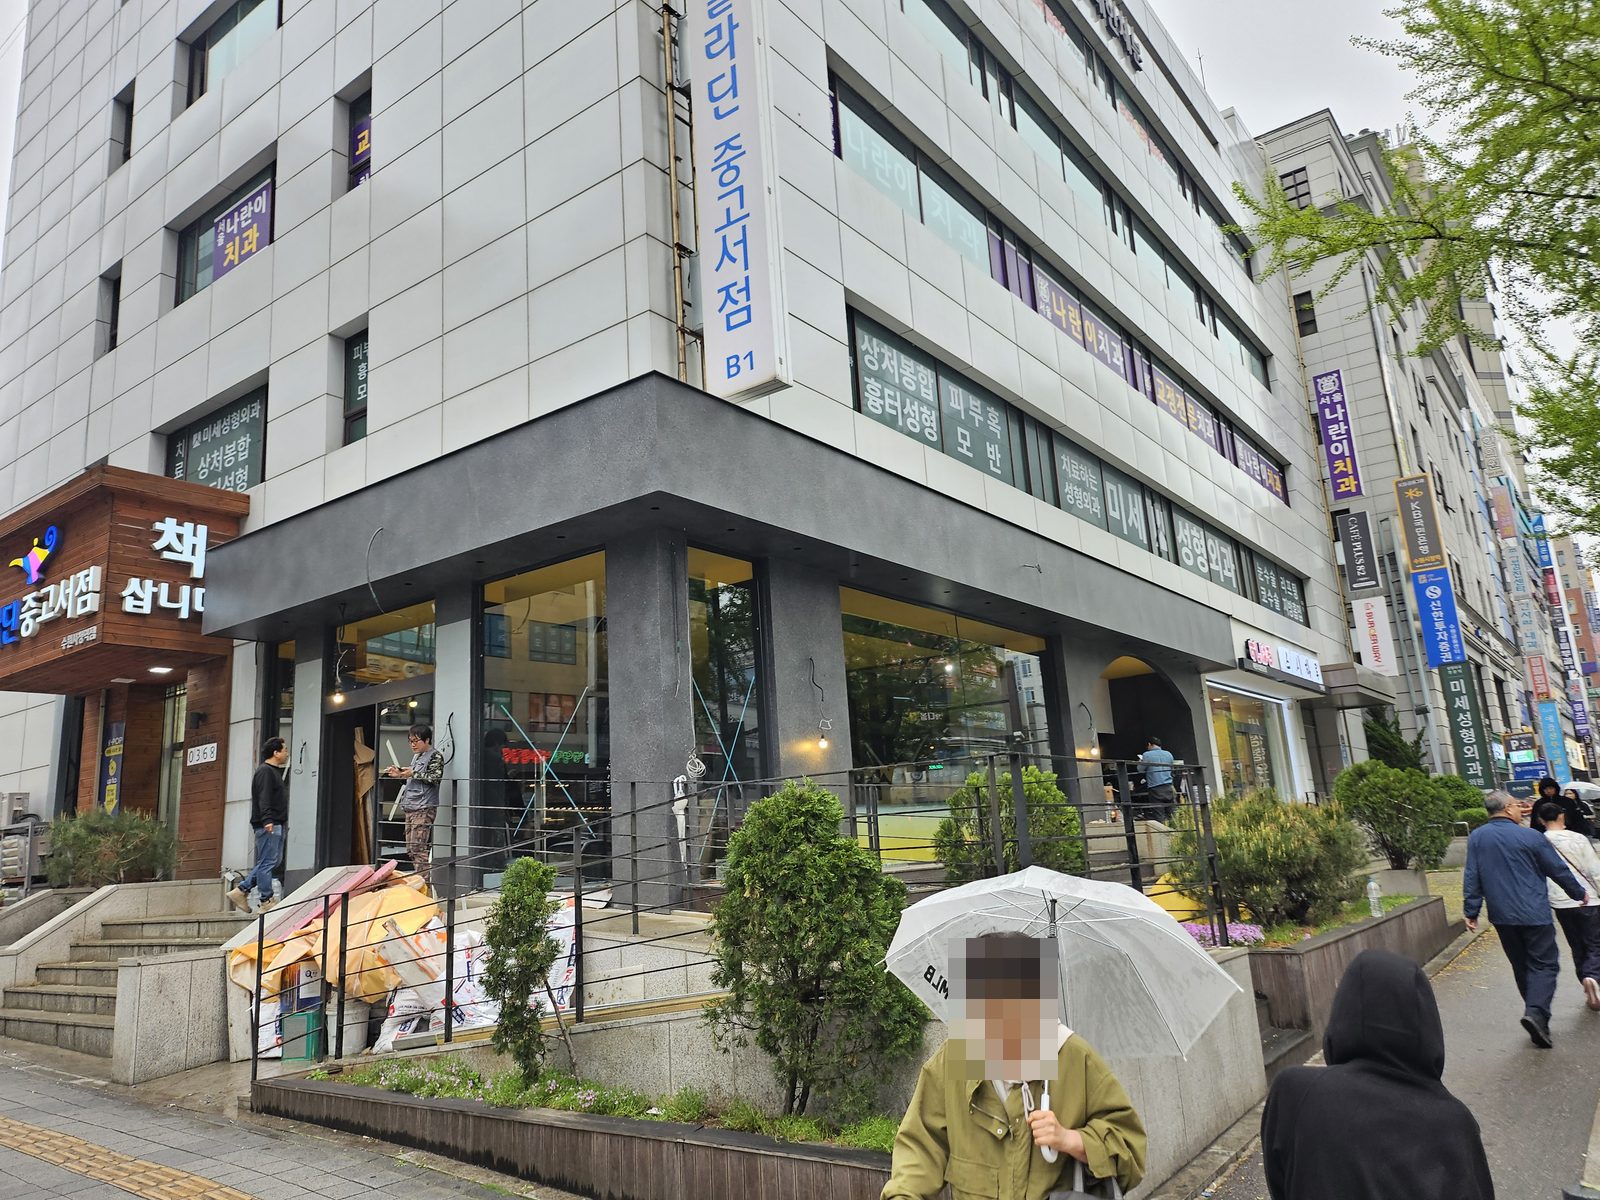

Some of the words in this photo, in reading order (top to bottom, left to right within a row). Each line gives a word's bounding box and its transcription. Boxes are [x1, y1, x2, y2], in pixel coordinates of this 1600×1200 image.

[226, 190, 267, 234] 나란이
[711, 132, 752, 332] 중고서점
[223, 223, 260, 267] 치과
[726, 350, 755, 379] B1
[860, 333, 935, 402] 상처봉합
[863, 375, 938, 443] 흉터성형
[1319, 392, 1343, 405] 서울
[203, 400, 261, 443] 미세성형외과
[197, 433, 252, 479] 상처봉합
[1061, 453, 1099, 492] 치료하는
[1064, 481, 1102, 519] 성형외과
[152, 517, 208, 579] 책
[1105, 480, 1148, 545] 미세
[1177, 520, 1237, 589] 성형외과
[1348, 517, 1362, 541] CAFÉ
[19, 566, 102, 638] 중고서점
[1449, 678, 1484, 777] 미세성형외과
[189, 745, 216, 764] 0368
